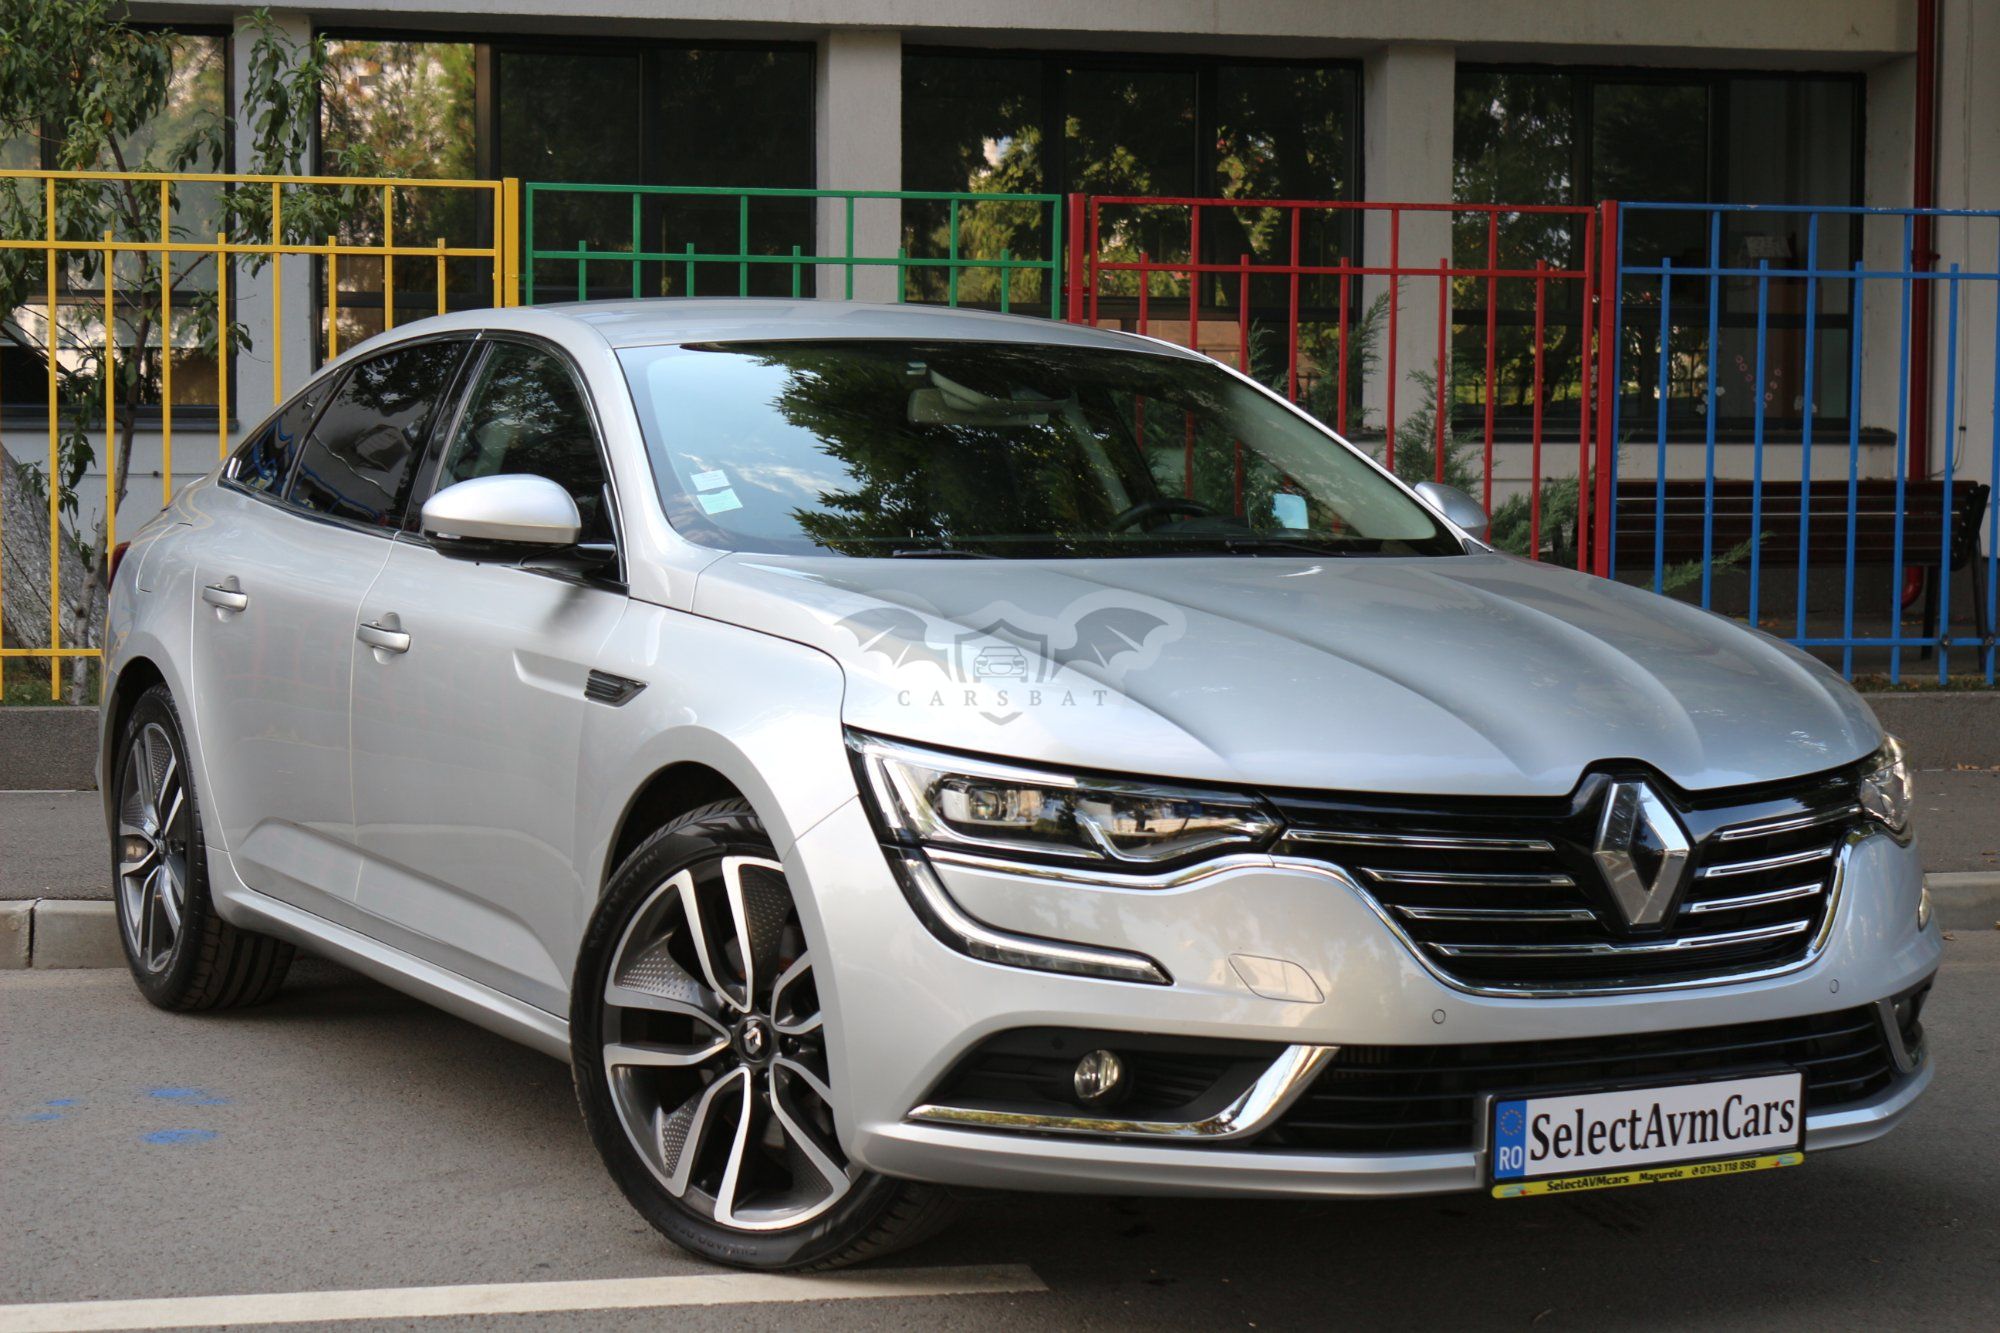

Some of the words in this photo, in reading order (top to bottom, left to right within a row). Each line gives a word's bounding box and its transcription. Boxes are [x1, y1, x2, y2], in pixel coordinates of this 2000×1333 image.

[1530, 1094, 1795, 1161] SelectAvmCars
[1499, 1146, 1523, 1170] RO
[1546, 1175, 1630, 1192] SelectAVMcars
[1639, 1168, 1683, 1183] Magurele
[1700, 1164, 1721, 1175] 0743
